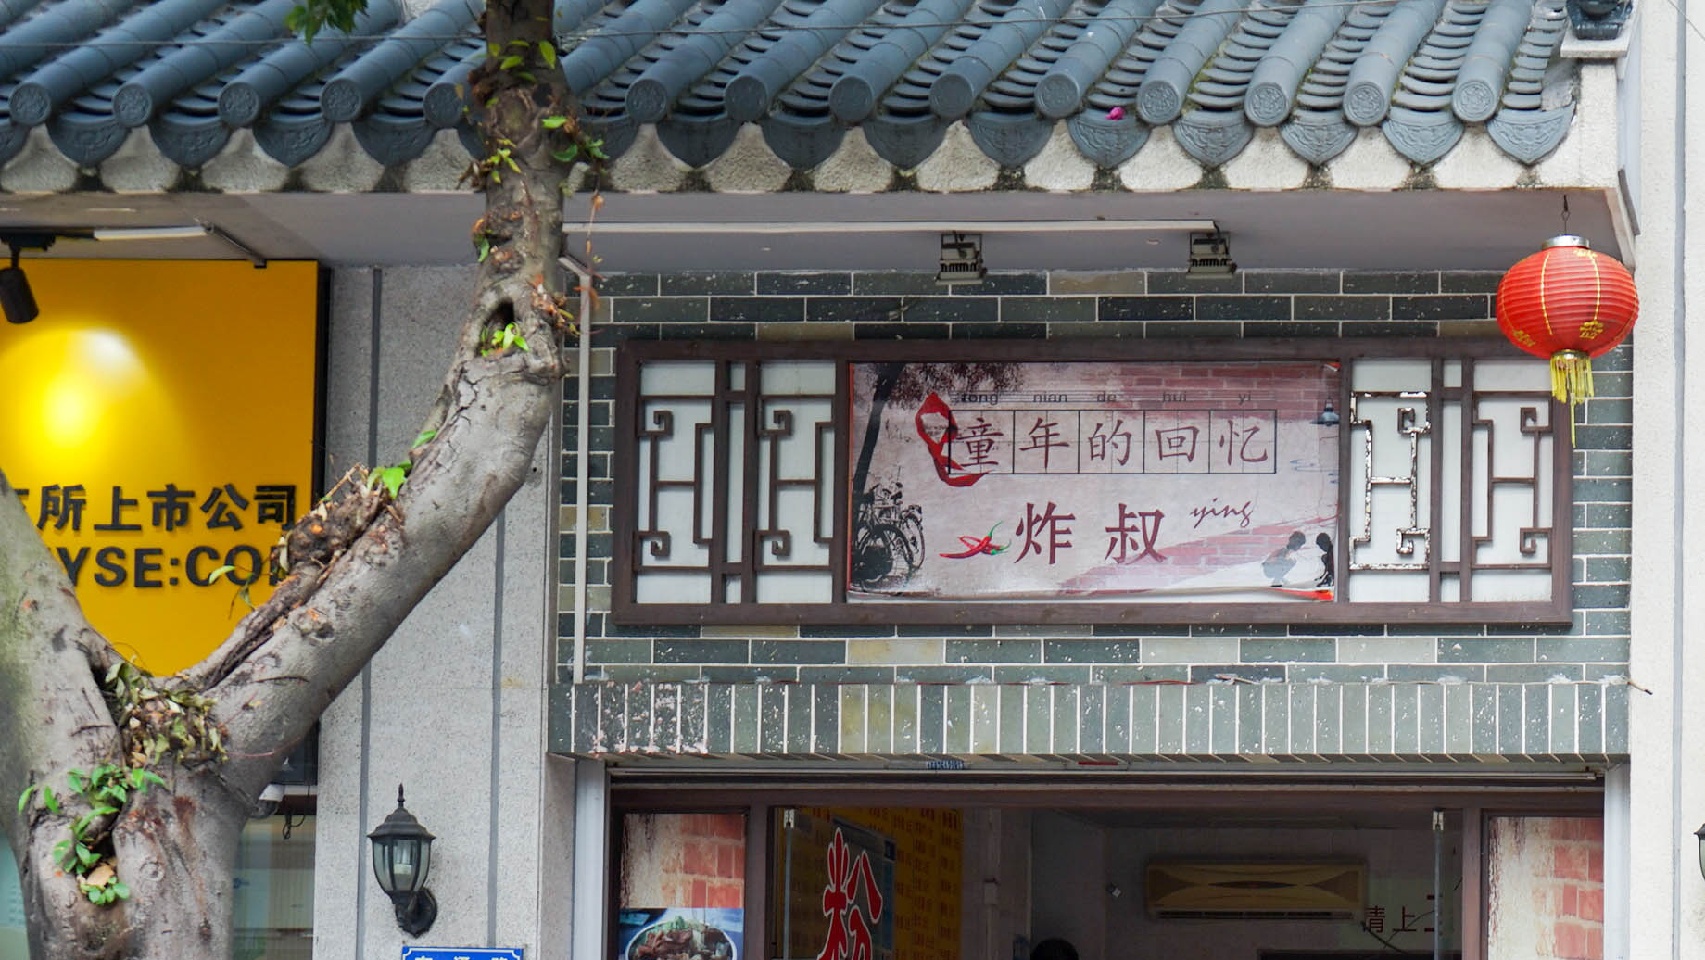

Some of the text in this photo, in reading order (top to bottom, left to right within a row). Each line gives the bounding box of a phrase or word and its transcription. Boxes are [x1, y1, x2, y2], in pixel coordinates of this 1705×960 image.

[1032, 391, 1068, 403] nian
[1096, 391, 1118, 403] de
[954, 417, 1269, 469] 童年的回忆
[14, 483, 298, 532] 所上市公司
[1014, 501, 1167, 565] 炸叔
[49, 545, 285, 588] YSE:CO
